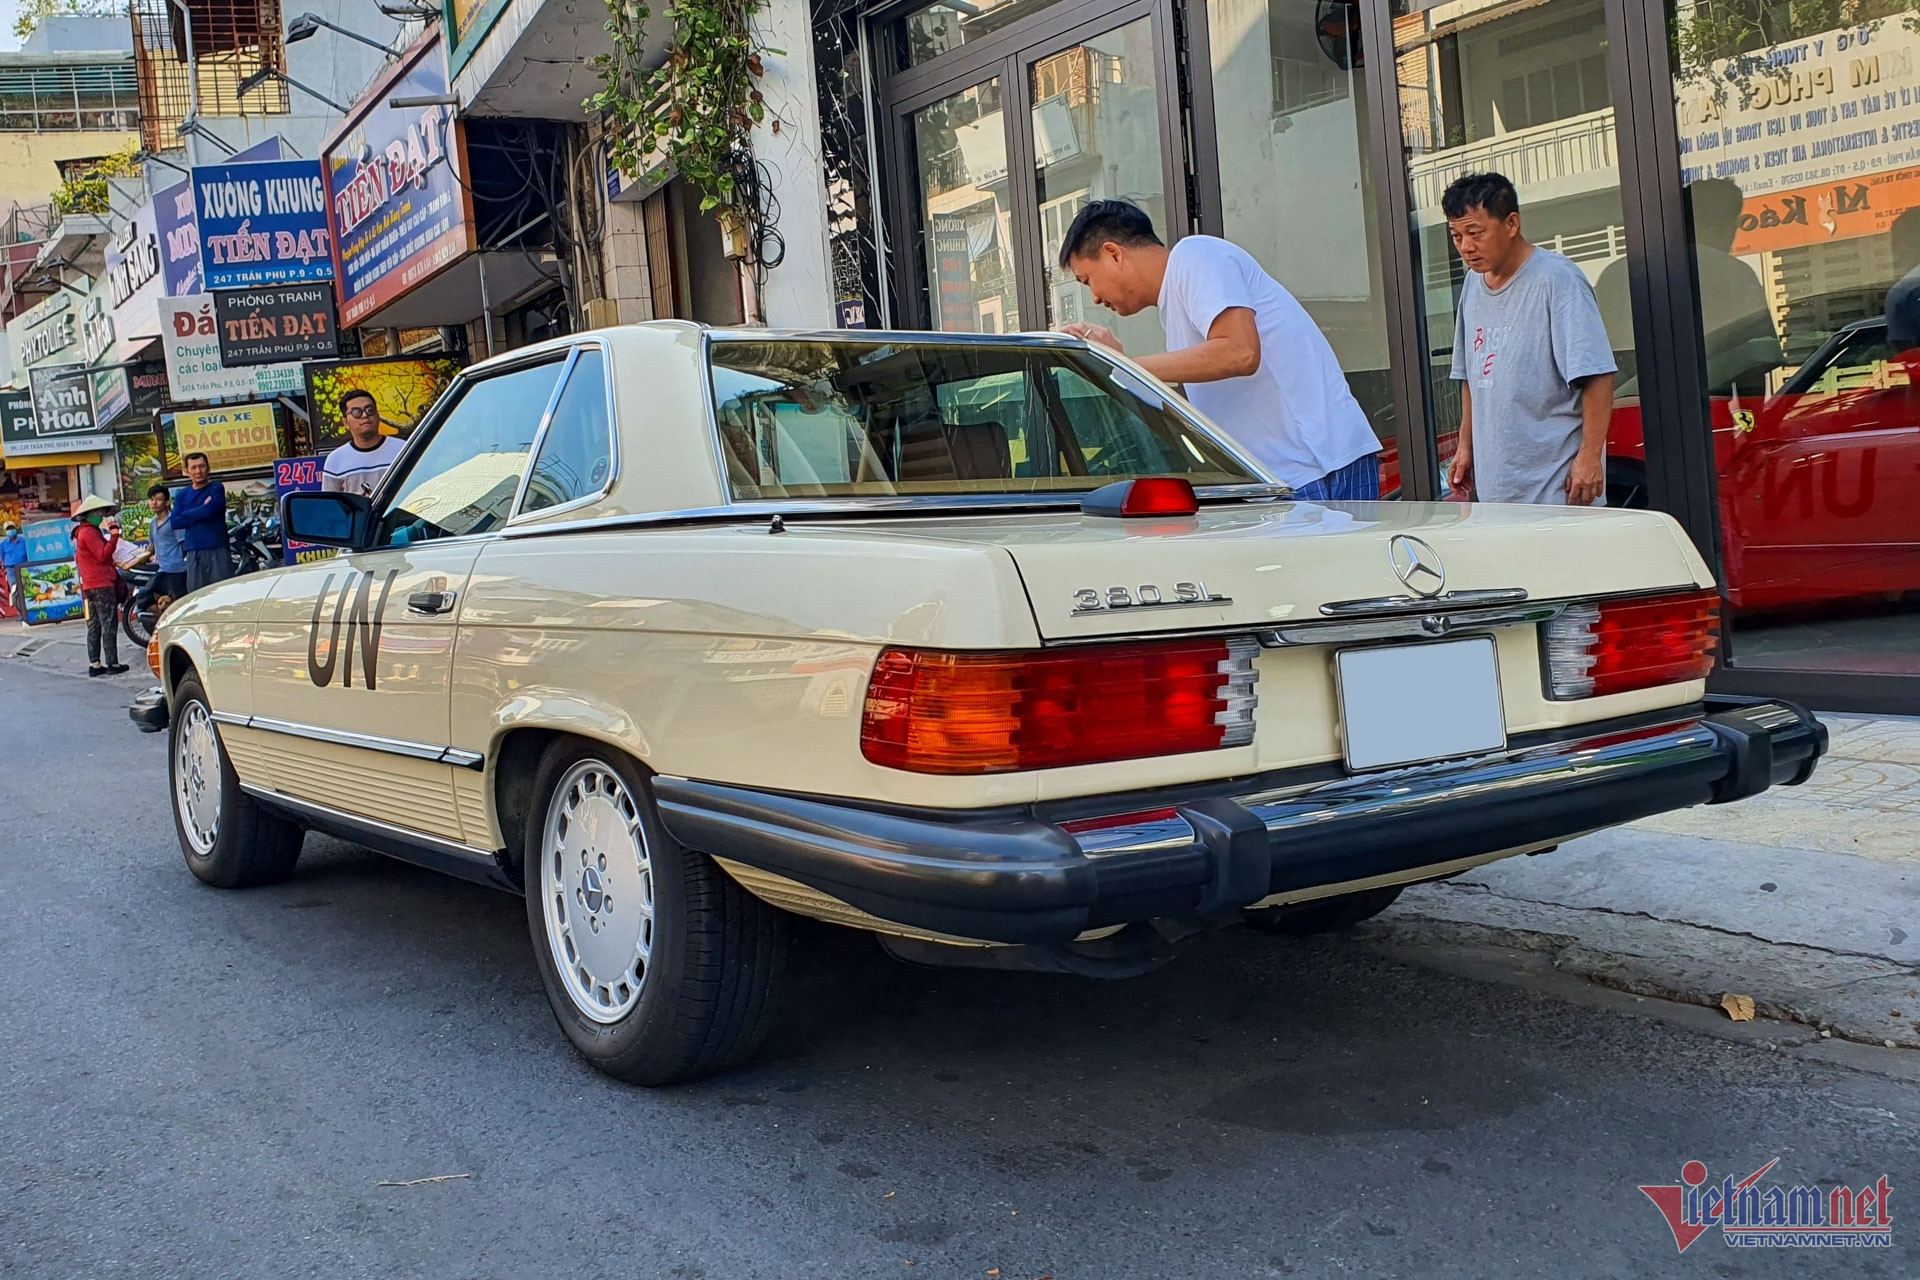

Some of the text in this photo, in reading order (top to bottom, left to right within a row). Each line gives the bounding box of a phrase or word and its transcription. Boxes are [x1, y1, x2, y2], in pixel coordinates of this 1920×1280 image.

[386, 104, 441, 196] ĐẠT
[201, 171, 324, 219] XƯỞNG KHUNG
[207, 219, 271, 264] TIẾN
[275, 229, 330, 265] ĐẠT
[214, 274, 232, 283] 247
[236, 270, 262, 282] TRẦN
[266, 270, 285, 280] PHÚ
[290, 269, 305, 278] P.9
[317, 267, 332, 277] Q.5
[228, 291, 322, 308] PHÒNG TRANH
[173, 303, 216, 337] Đắ
[225, 308, 277, 341] TIẾN
[283, 312, 327, 341] ĐẠT
[20, 314, 72, 366] PHYTOLIFE
[176, 344, 220, 359] Chuyên
[228, 349, 243, 358] 247
[247, 345, 272, 356] TRẦN
[274, 342, 294, 353] PHÚ
[297, 343, 309, 352] P.9
[317, 341, 333, 350] Q.5
[179, 361, 199, 375] các
[13, 416, 36, 432] PH
[41, 409, 90, 430] Hoa
[198, 412, 252, 426] SỬA XE
[184, 422, 272, 450] ĐẮC THỜI
[278, 461, 316, 486] 247
[295, 548, 337, 564] KHUN
[1073, 582, 1222, 609] 380 SL
[308, 569, 399, 690] UN
